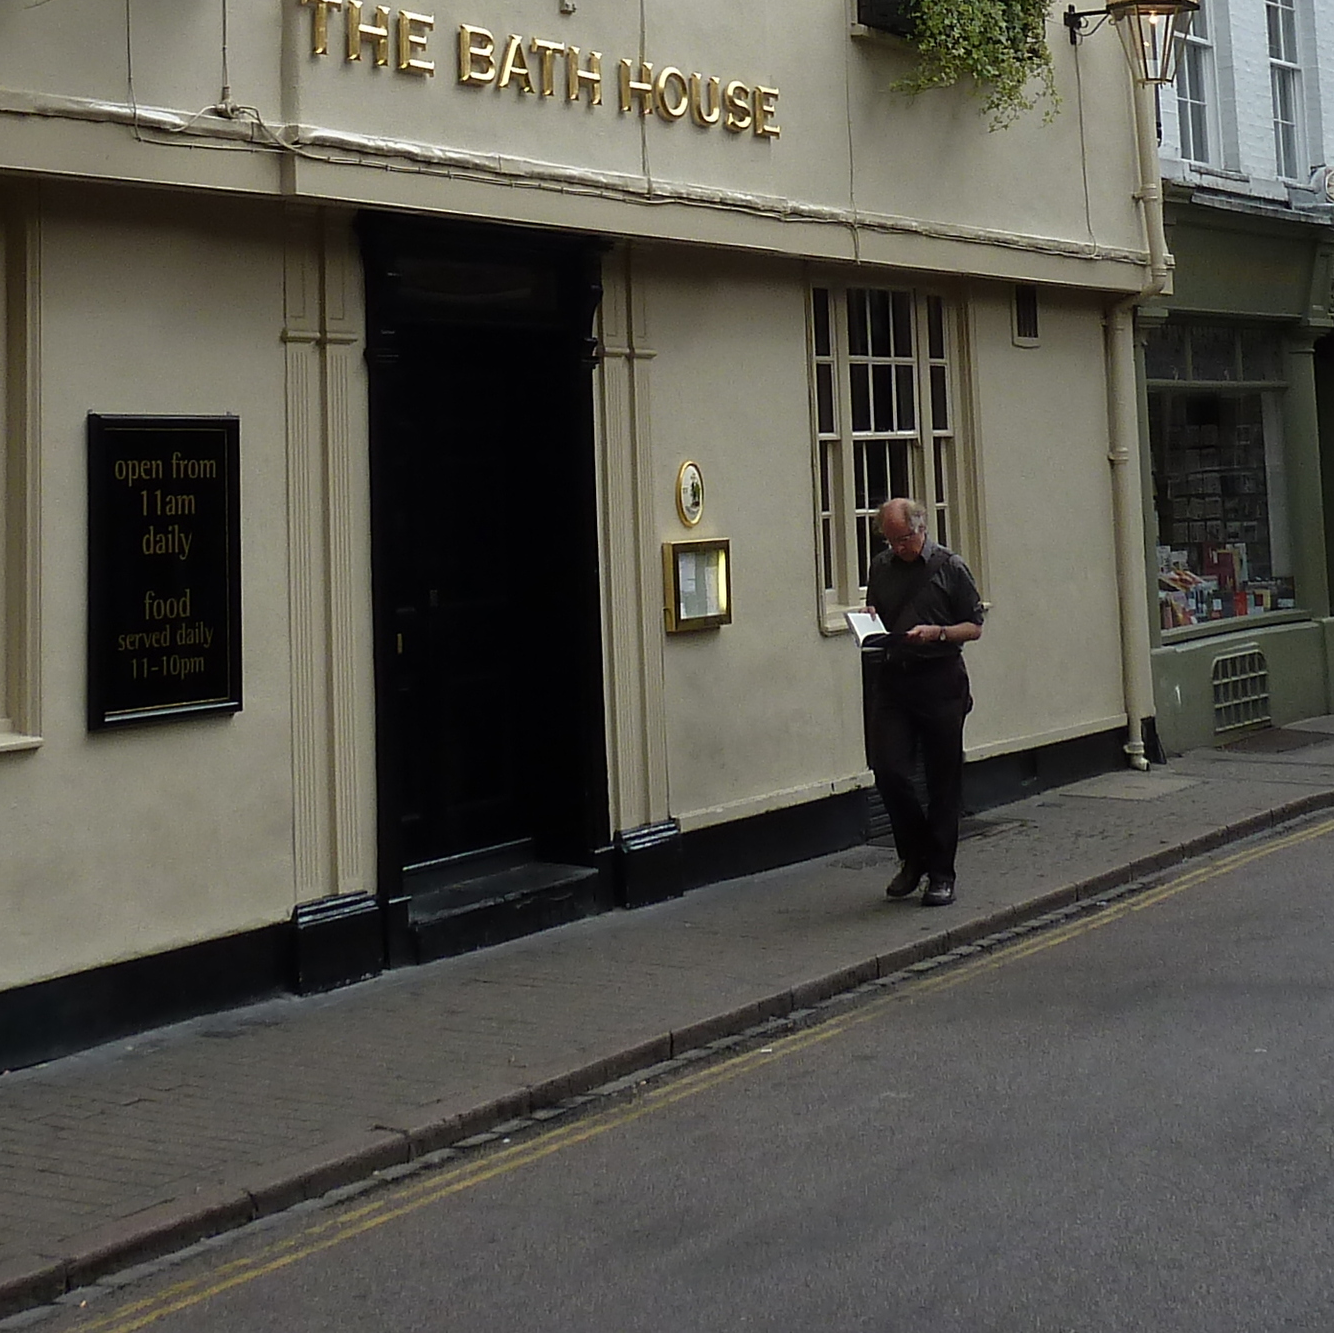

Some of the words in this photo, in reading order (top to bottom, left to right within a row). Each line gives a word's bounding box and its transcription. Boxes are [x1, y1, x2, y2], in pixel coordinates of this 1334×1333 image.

[458, 22, 603, 105] BATH
[620, 57, 780, 138] HOUSE
[114, 459, 162, 486] open
[171, 452, 216, 479] from
[140, 489, 195, 515] 11am
[142, 525, 192, 560] daily
[144, 589, 190, 619] food
[118, 625, 169, 651] served
[176, 621, 213, 648] daily
